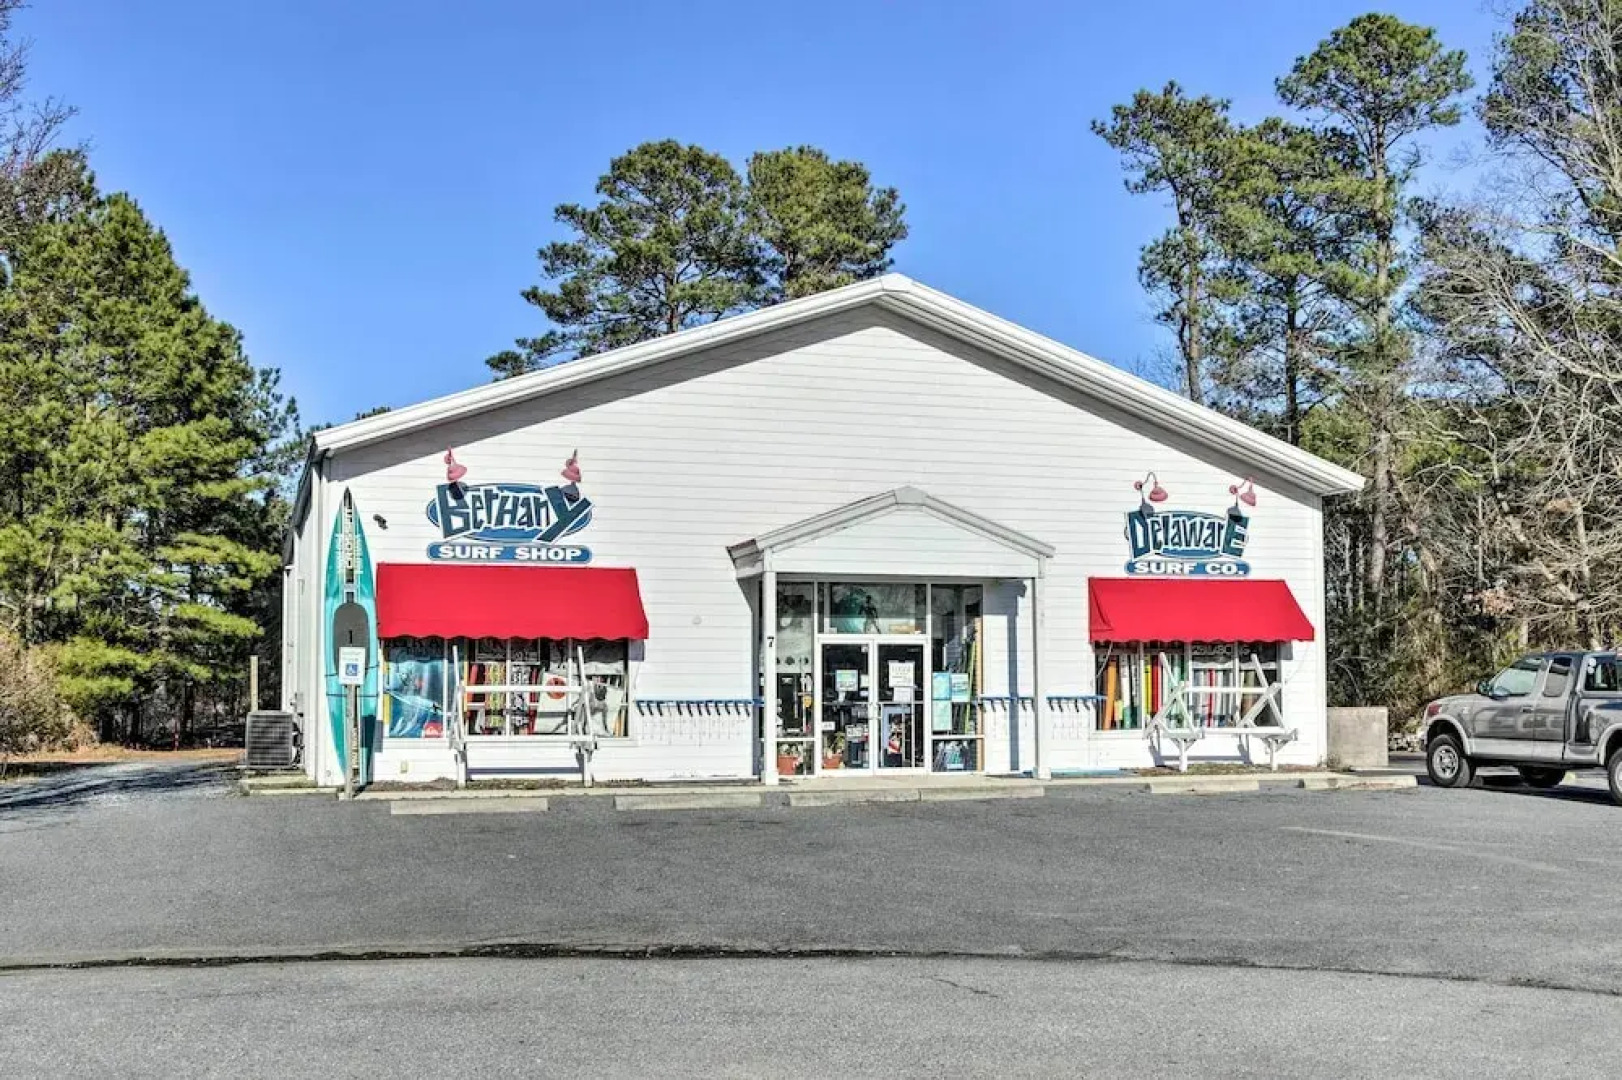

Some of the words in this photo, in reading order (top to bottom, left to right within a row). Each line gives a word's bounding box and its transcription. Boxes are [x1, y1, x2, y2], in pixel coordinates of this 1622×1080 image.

[438, 544, 505, 559] SURF
[514, 546, 582, 561] SHOP
[1134, 561, 1198, 574] SURF
[1205, 562, 1245, 575] CO.
[766, 636, 775, 648] 7
